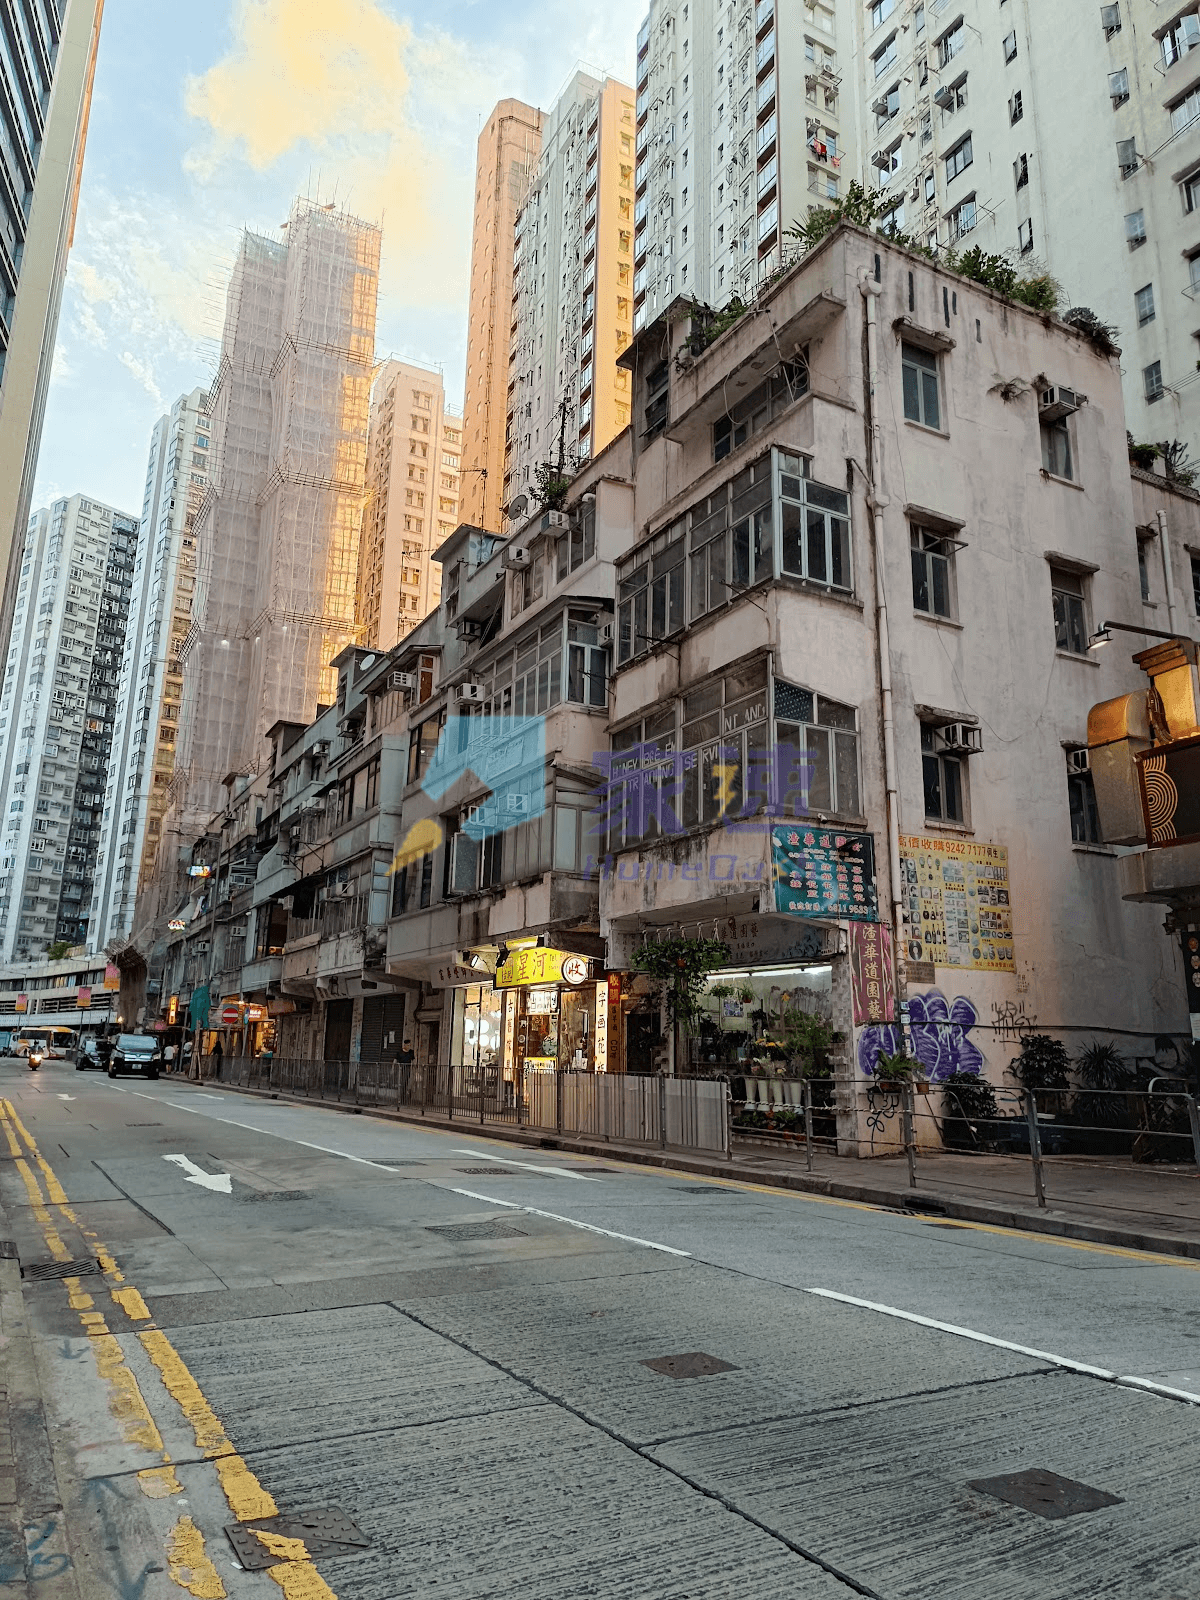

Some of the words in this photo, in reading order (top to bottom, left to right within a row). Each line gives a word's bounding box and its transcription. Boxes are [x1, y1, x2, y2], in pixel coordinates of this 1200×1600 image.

[612, 757, 638, 778] HNEY
[945, 842, 965, 855] 9242
[967, 844, 986, 857] 7177
[516, 951, 549, 981] 星河
[567, 959, 584, 977] 收
[862, 923, 883, 1020] 渣華道園藝
